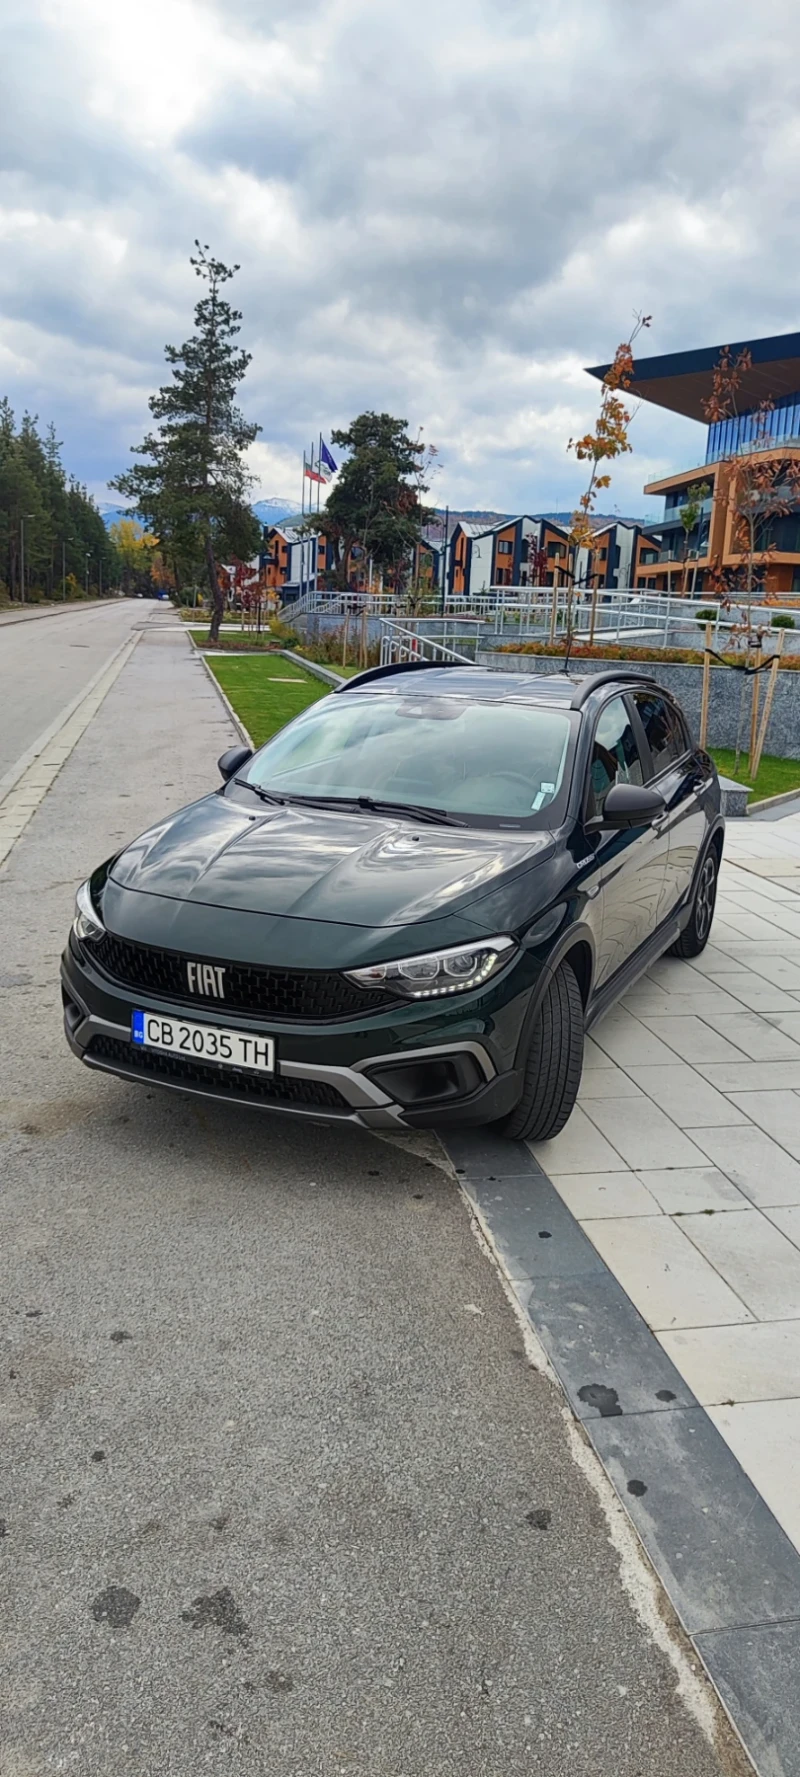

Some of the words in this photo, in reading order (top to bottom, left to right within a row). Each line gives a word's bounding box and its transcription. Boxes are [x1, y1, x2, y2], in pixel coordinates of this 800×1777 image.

[187, 961, 226, 999] FIAT
[134, 1030, 143, 1039] BG
[147, 1019, 174, 1046] CB
[179, 1027, 232, 1058] 2035
[238, 1038, 268, 1066] TH
